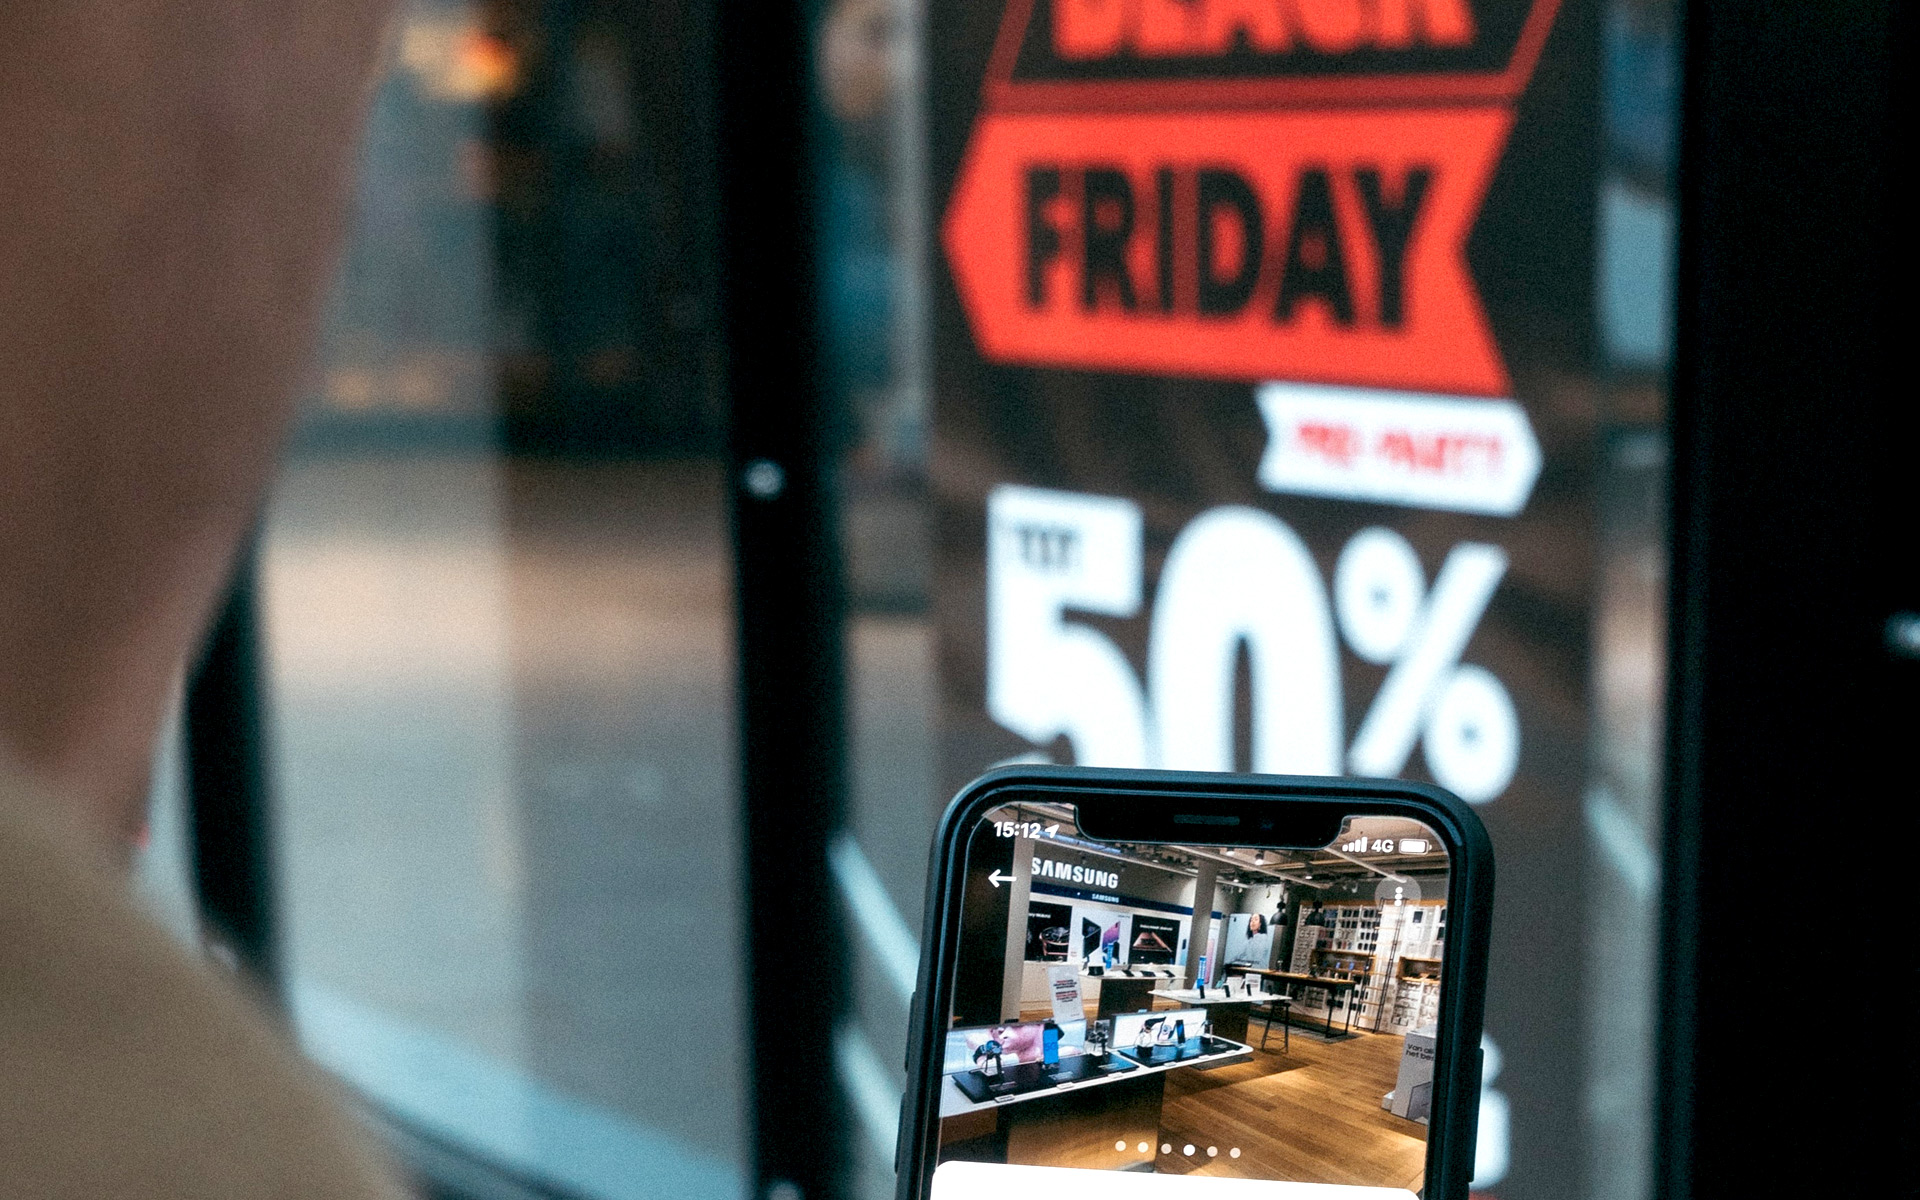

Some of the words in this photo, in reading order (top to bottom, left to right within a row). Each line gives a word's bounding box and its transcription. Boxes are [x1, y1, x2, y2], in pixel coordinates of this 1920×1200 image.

[1023, 162, 1437, 334] FRIDAY
[986, 484, 1522, 803] 50%
[993, 821, 1041, 839] 15:12
[1370, 839, 1394, 853] 4G
[1031, 857, 1119, 889] SAMSUNG
[1405, 1050, 1420, 1058] het
